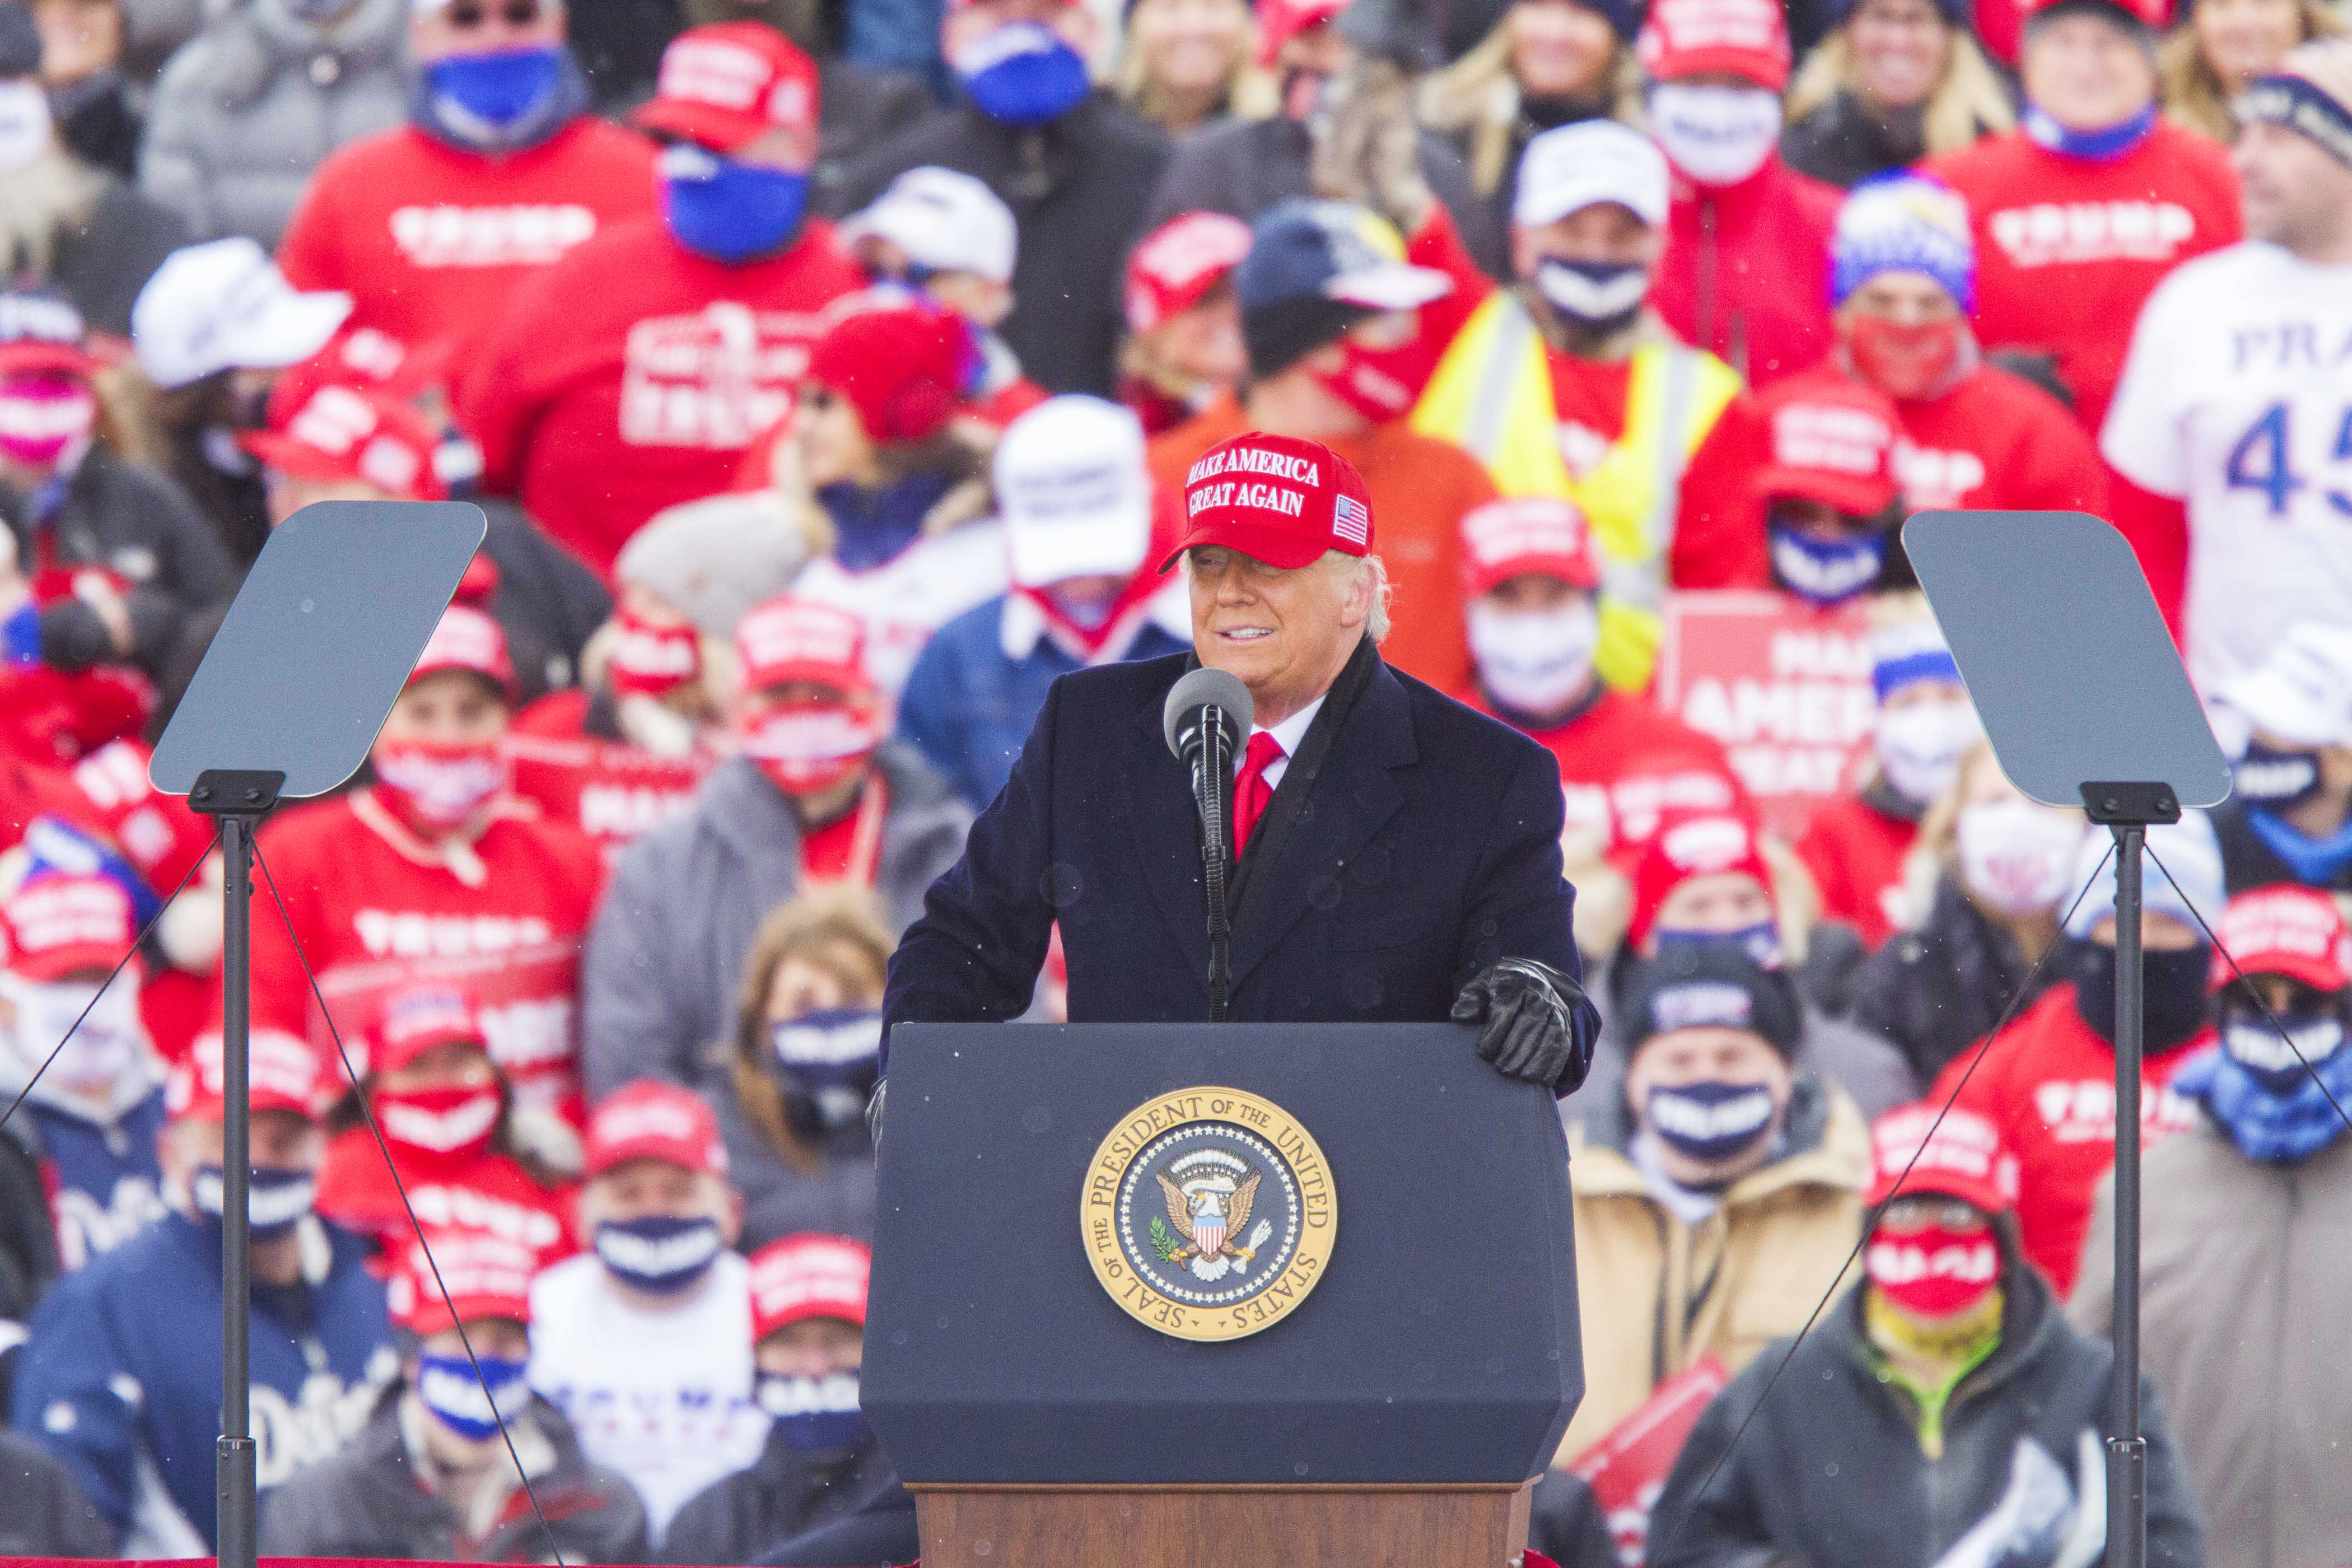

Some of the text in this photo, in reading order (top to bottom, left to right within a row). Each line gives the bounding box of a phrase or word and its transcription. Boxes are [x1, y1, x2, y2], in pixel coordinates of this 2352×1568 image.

[1991, 203, 2194, 245] TRUMP
[1186, 448, 1319, 487] MAKE AMERICA
[1189, 482, 1304, 517] GREAT AGAIN
[1091, 1096, 1328, 1328] SEAL OF THE PRESIDENT OF THE UNITED STATES
